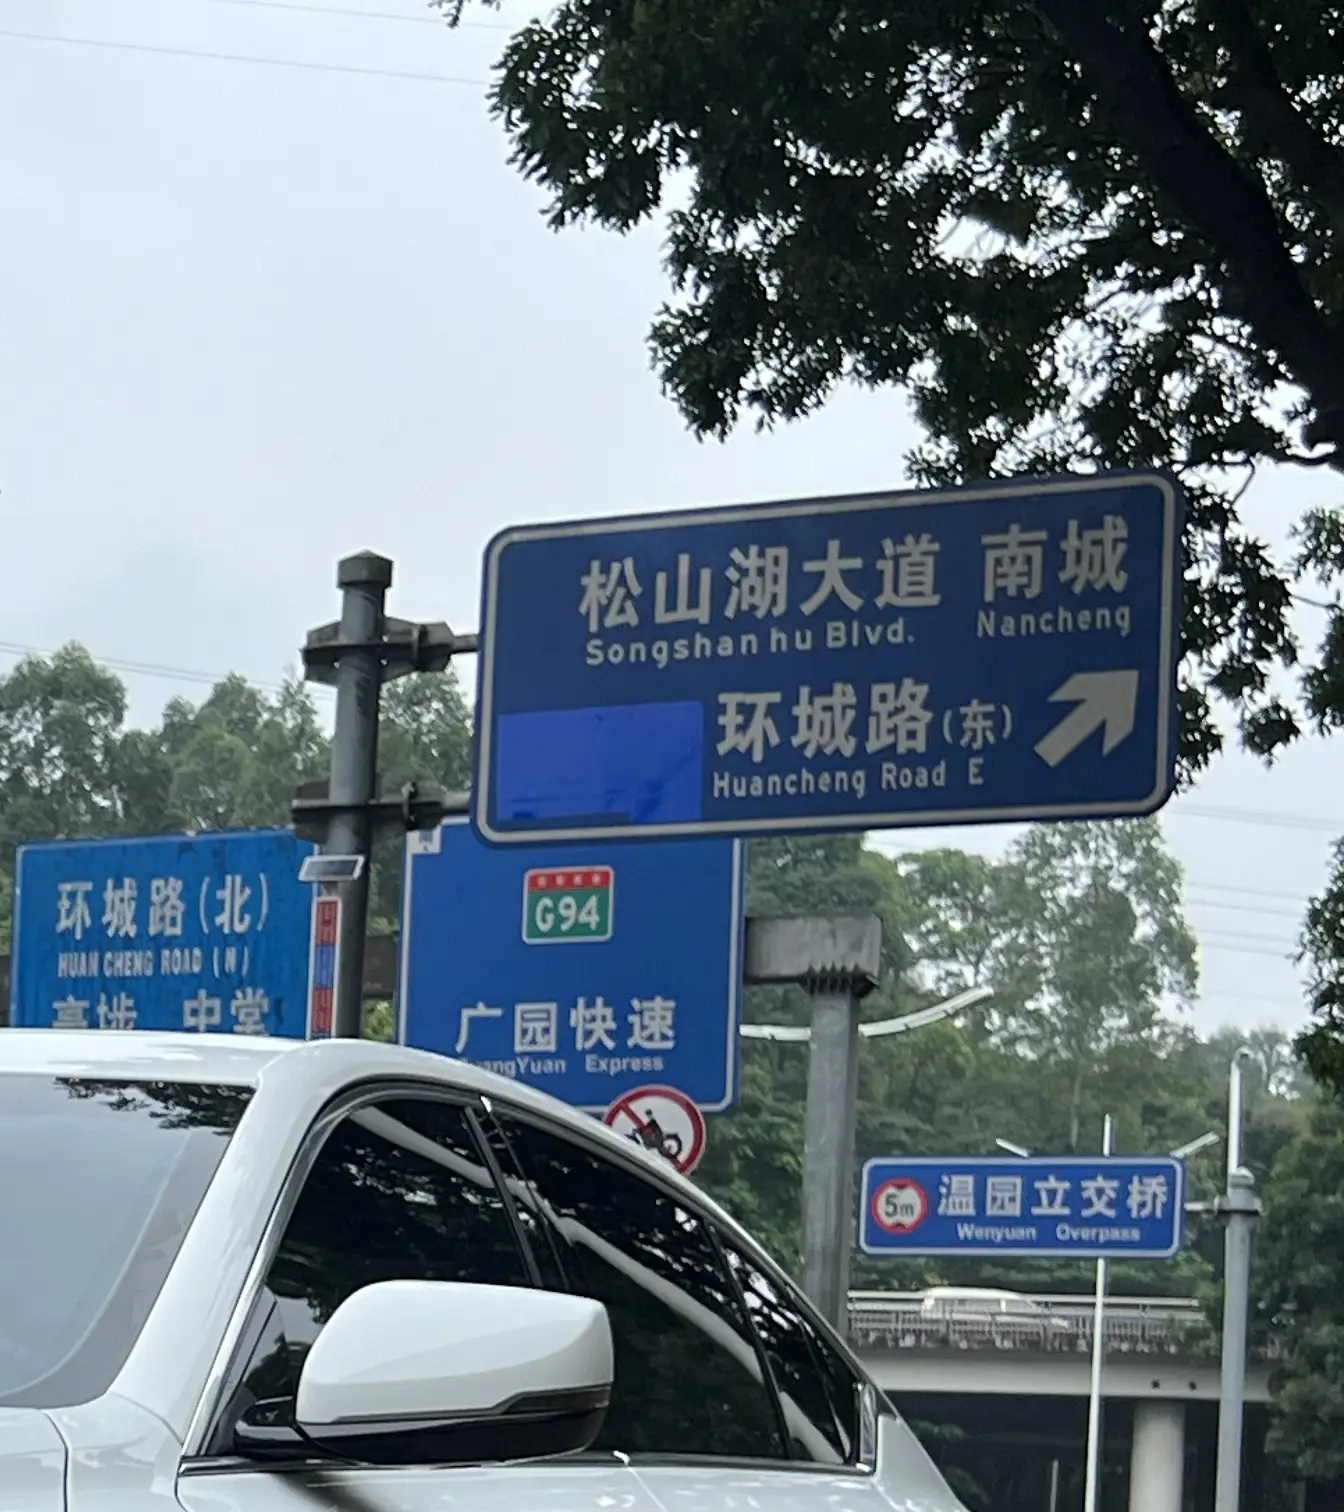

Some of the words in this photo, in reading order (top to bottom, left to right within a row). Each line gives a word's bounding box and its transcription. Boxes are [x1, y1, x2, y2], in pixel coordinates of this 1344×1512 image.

[578, 533, 942, 633] 松山湖大道
[978, 515, 1130, 603] 南城
[584, 629, 759, 669] Songshan
[770, 626, 813, 654] hu
[825, 617, 916, 650] Blvd.
[975, 606, 1131, 640] Nancheng
[715, 678, 1014, 763] 环城路(东)
[712, 765, 867, 801] Huancheng
[881, 762, 947, 790] Road
[967, 758, 984, 787] E
[534, 894, 601, 933] G94
[57, 951, 99, 979] HUAN
[103, 949, 154, 979] CHENG
[161, 947, 203, 976] ROAD
[182, 987, 270, 1037] 中堂
[454, 995, 677, 1054] 广园快速
[584, 1053, 665, 1077] Express
[883, 1192, 916, 1219] 5m
[937, 1174, 1169, 1220] 温园立交桥
[957, 1222, 1038, 1243] Wenyuan
[1055, 1223, 1141, 1243] Overpass
